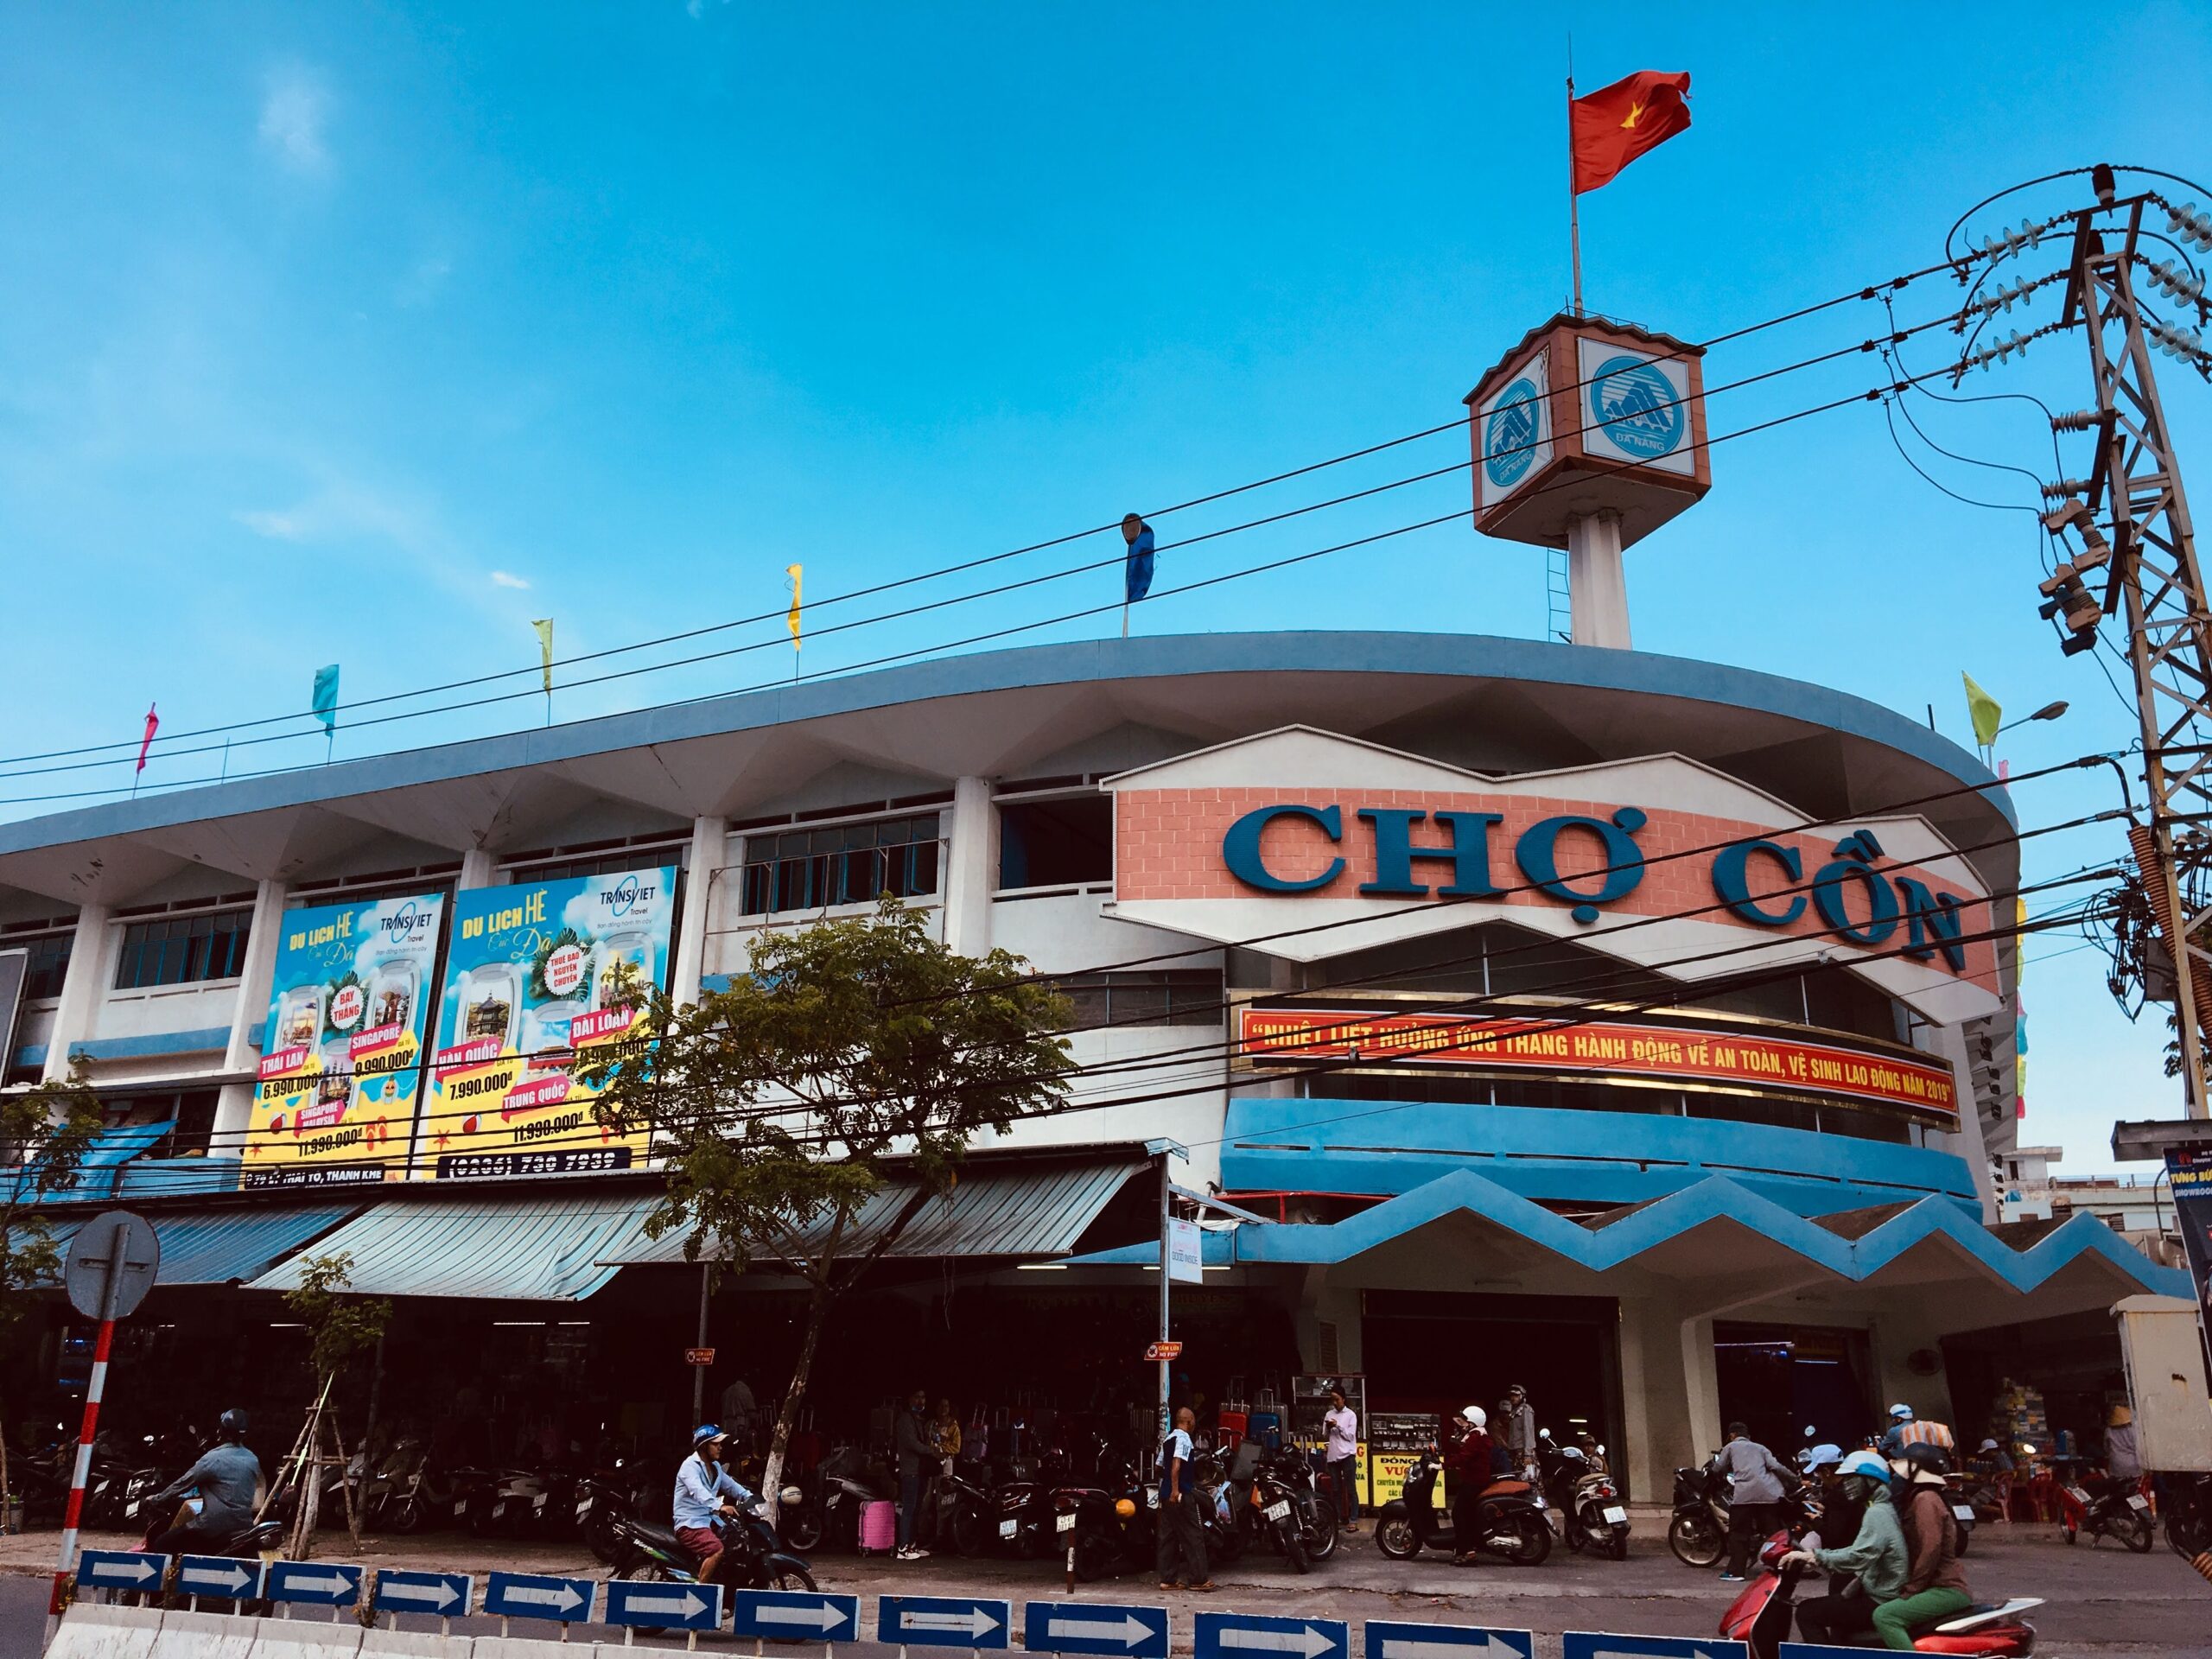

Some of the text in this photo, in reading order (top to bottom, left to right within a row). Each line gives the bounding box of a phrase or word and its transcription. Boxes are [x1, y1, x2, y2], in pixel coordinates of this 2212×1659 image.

[600, 886, 656, 906] TRANSVIET
[1223, 804, 1966, 971] CHỢ CỒN
[380, 913, 432, 932] TRANSVIET
[462, 888, 548, 940] DU LỊCH HÈ
[289, 910, 354, 950] DU LỊCH HÈ
[340, 990, 354, 1005] BAY
[573, 1009, 629, 1039] ĐÀI LOAN
[352, 1027, 400, 1049] SINGAPORE
[262, 1052, 303, 1074] THÁI LAN
[438, 1040, 499, 1071] HÀN QUỐC
[1574, 1032, 1626, 1059] HÀNH
[1632, 1037, 1682, 1066] ĐỘNG
[1688, 1039, 1710, 1066] VỀ
[1715, 1047, 1737, 1069] AN
[1740, 1046, 1786, 1077] TOÀN,
[1789, 1052, 1808, 1082] VỆ
[1810, 1058, 1842, 1082] SINH
[1845, 1064, 1868, 1086] LAO
[1871, 1065, 1901, 1092] ĐỘNG
[1903, 1071, 1925, 1097] NĂM
[450, 1071, 512, 1101] 7.990.000đ
[504, 1083, 565, 1109] TRUNG QUỐC
[301, 1102, 339, 1121] SINGAPORE
[302, 1114, 336, 1128] MALAYSIA
[327, 1171, 361, 1181] THANH
[2175, 1187, 2212, 1198] SHOWROO
